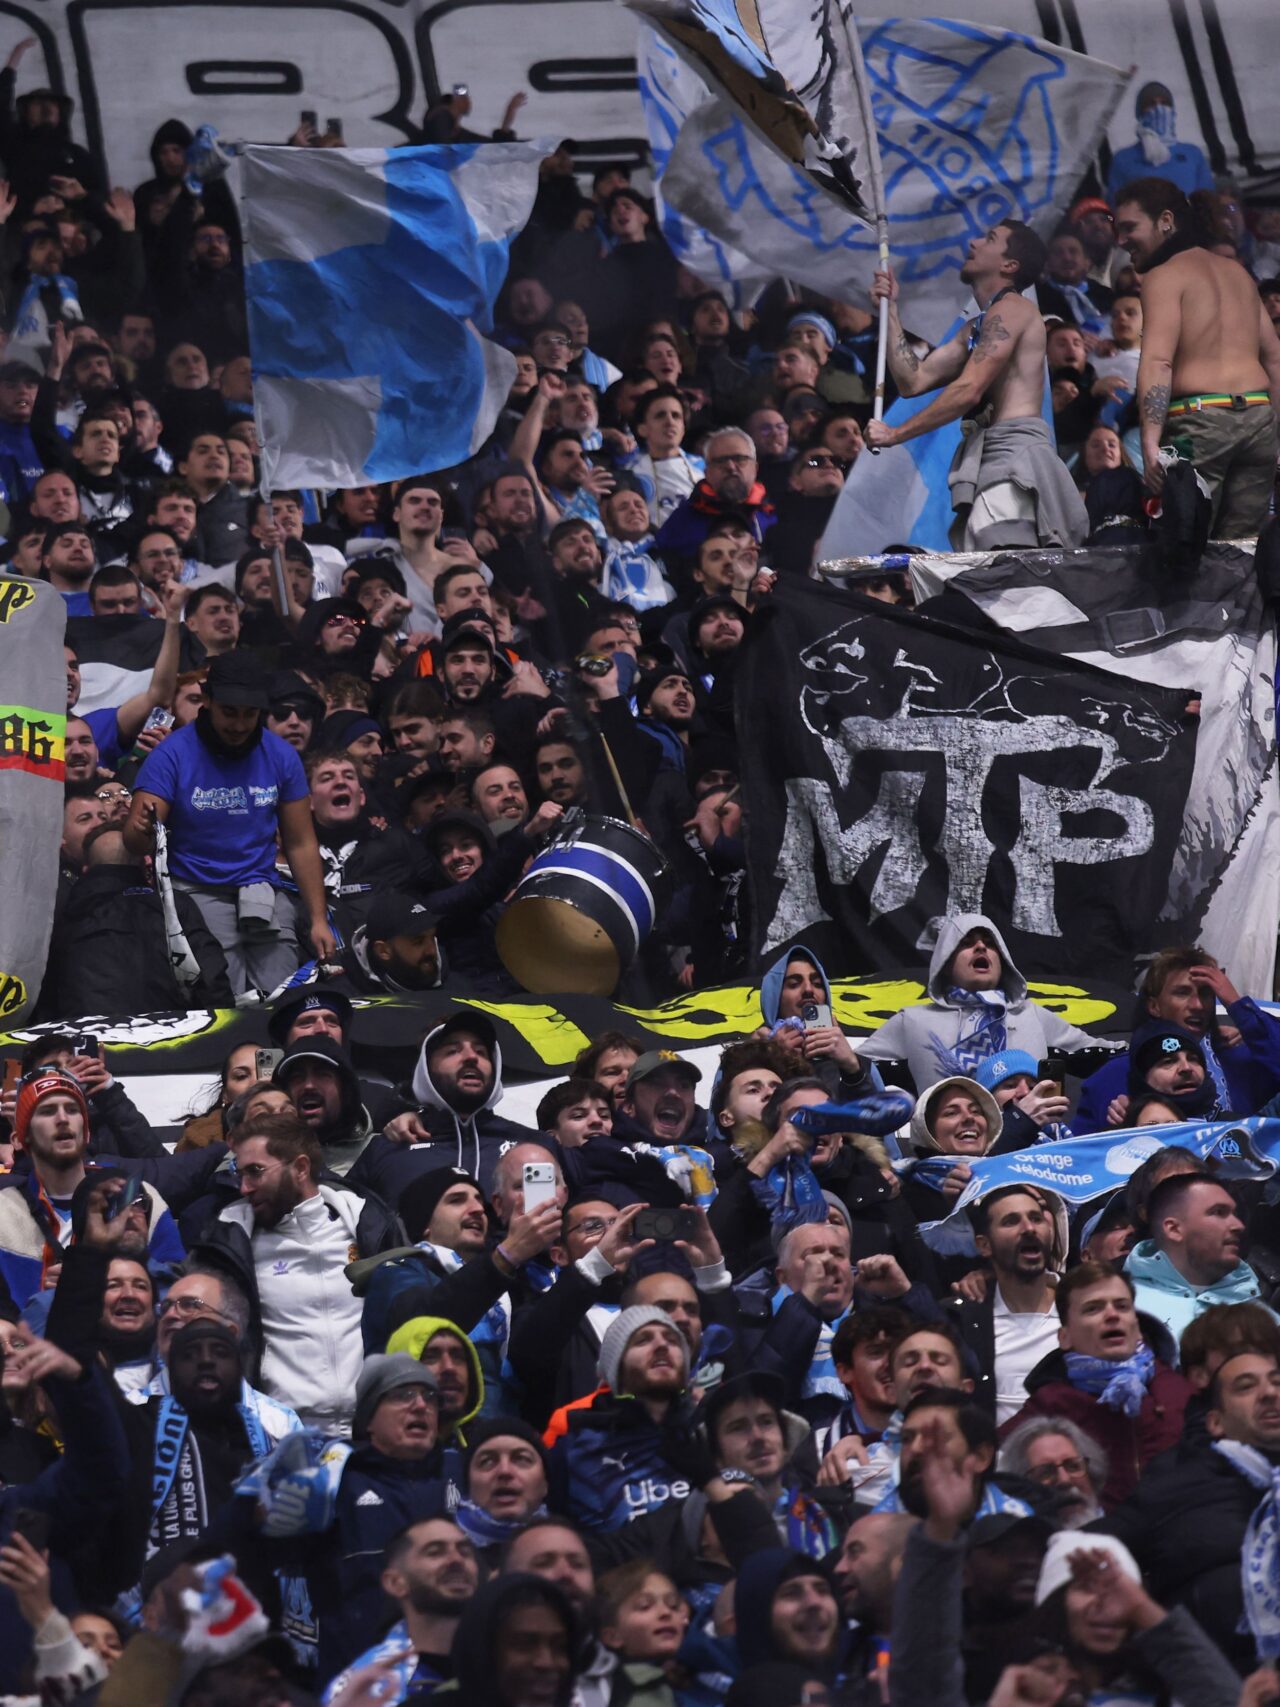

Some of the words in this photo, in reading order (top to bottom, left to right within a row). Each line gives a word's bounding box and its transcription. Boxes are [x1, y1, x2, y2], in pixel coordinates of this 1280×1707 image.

[761, 715, 1155, 956] MTP
[163, 1485, 179, 1520] LIGU
[182, 1481, 199, 1523] PLUS
[623, 1478, 690, 1506] Ube
[164, 1521, 180, 1540] LA
